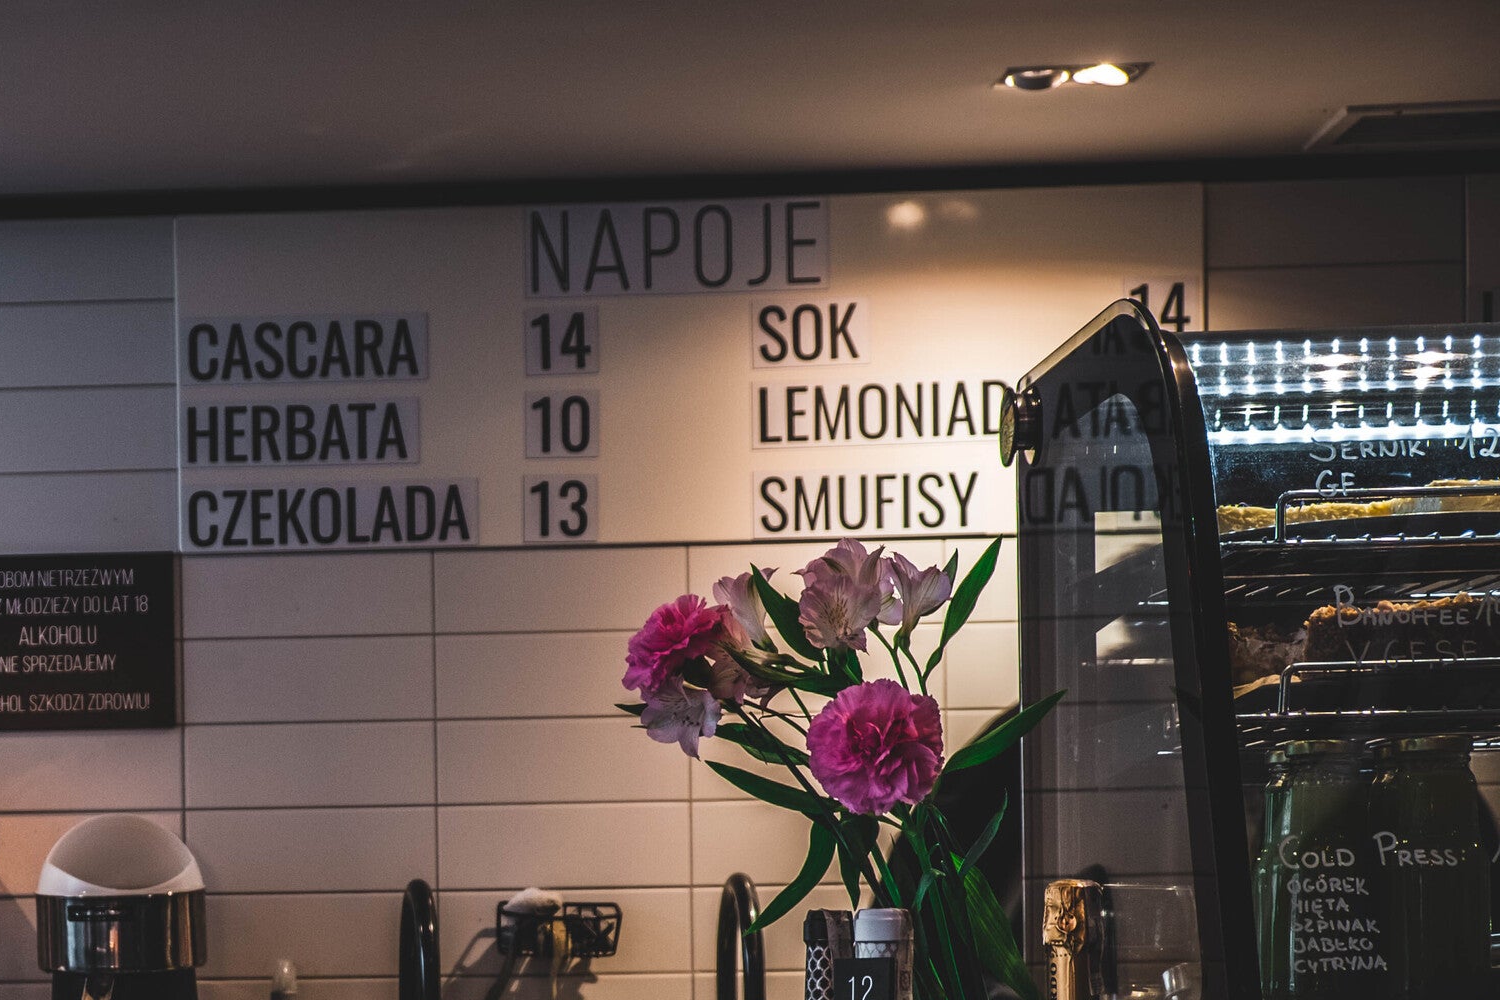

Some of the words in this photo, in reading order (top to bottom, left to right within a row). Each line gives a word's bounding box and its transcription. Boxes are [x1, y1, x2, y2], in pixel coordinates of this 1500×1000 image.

[530, 202, 822, 293] NAPOJE
[187, 318, 419, 381] CASCARA
[530, 311, 592, 370] 14
[758, 302, 860, 363] SOK
[186, 402, 408, 463] HERBATA
[530, 395, 591, 453] 10
[1309, 437, 1426, 463] SERNIK
[1315, 469, 1356, 498] GF
[187, 484, 471, 548] CZEKOLADA
[530, 480, 589, 538] 13
[760, 471, 979, 532] SMUFISY
[83, 595, 101, 613] DO
[103, 595, 129, 613] LAT
[134, 594, 149, 613] 18
[18, 625, 98, 646] ALKOHOLU
[0, 655, 19, 673] NIE
[22, 654, 117, 673] SPRZEDAJEMY
[29, 693, 84, 712] SZKODZI
[88, 692, 151, 711] ZDROWIU!
[1278, 834, 1356, 869] COLD
[1293, 955, 1388, 974] CYTRYNA
